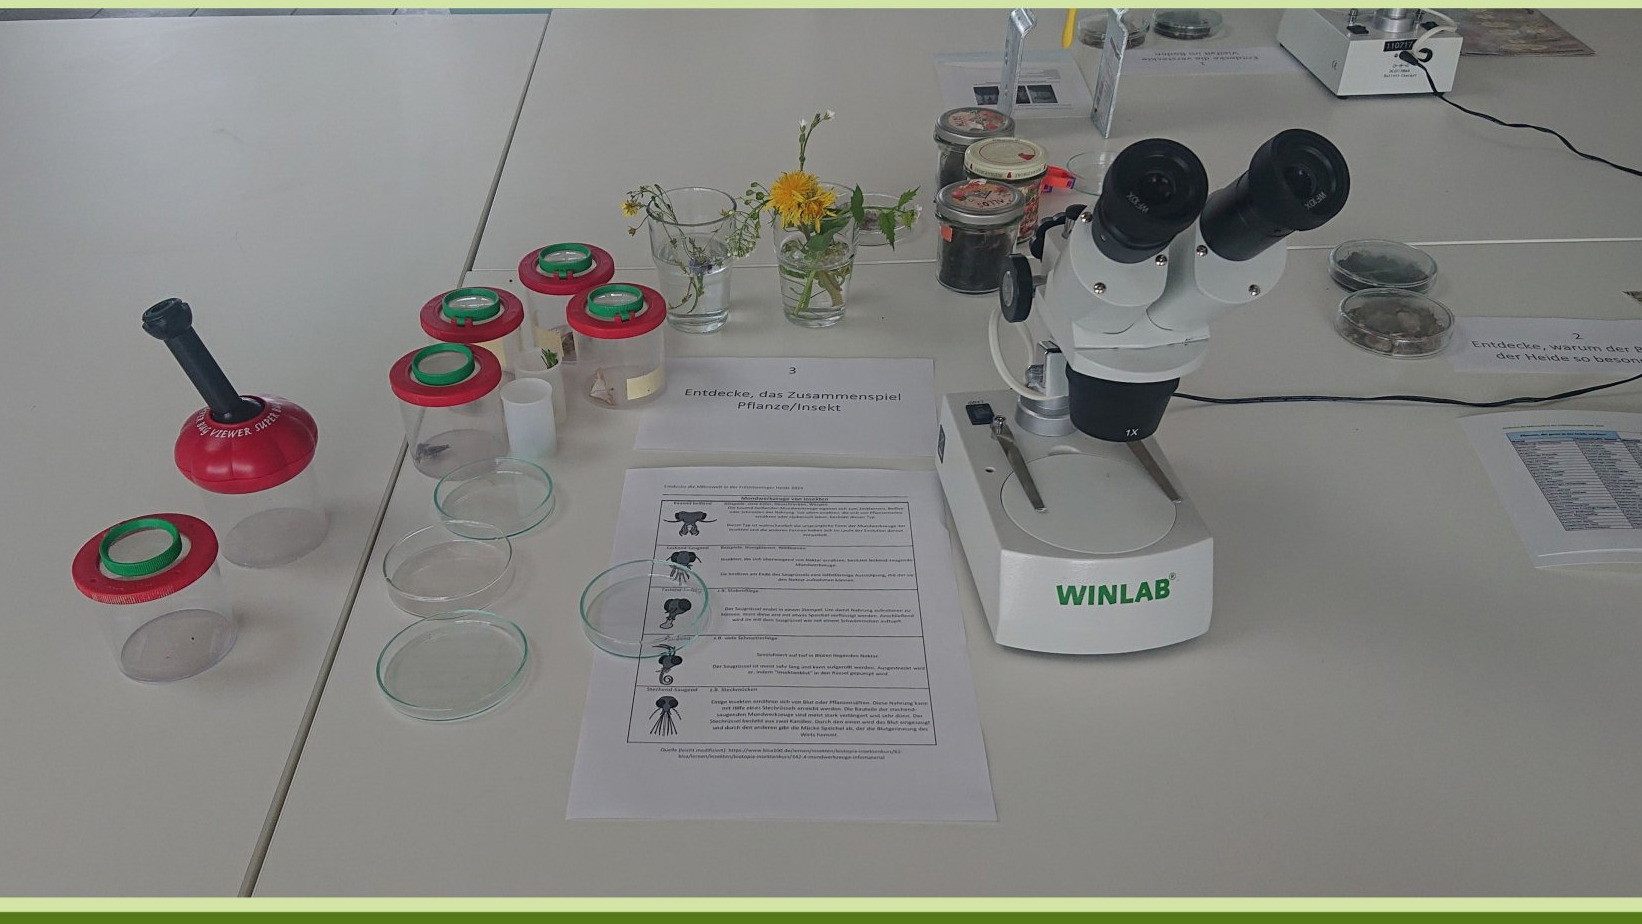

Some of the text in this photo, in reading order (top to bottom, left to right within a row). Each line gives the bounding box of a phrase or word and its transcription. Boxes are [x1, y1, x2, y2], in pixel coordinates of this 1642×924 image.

[1471, 340, 1546, 350] Entdecke,
[1593, 355, 1642, 364] beson
[789, 367, 797, 375] 3
[685, 388, 902, 402] Entdecke, das Zusammenspiel
[738, 401, 841, 411] Pflanze/Insekt
[210, 427, 252, 438] VIEWER
[255, 412, 280, 432] SUPER
[1125, 428, 1139, 437] 1X
